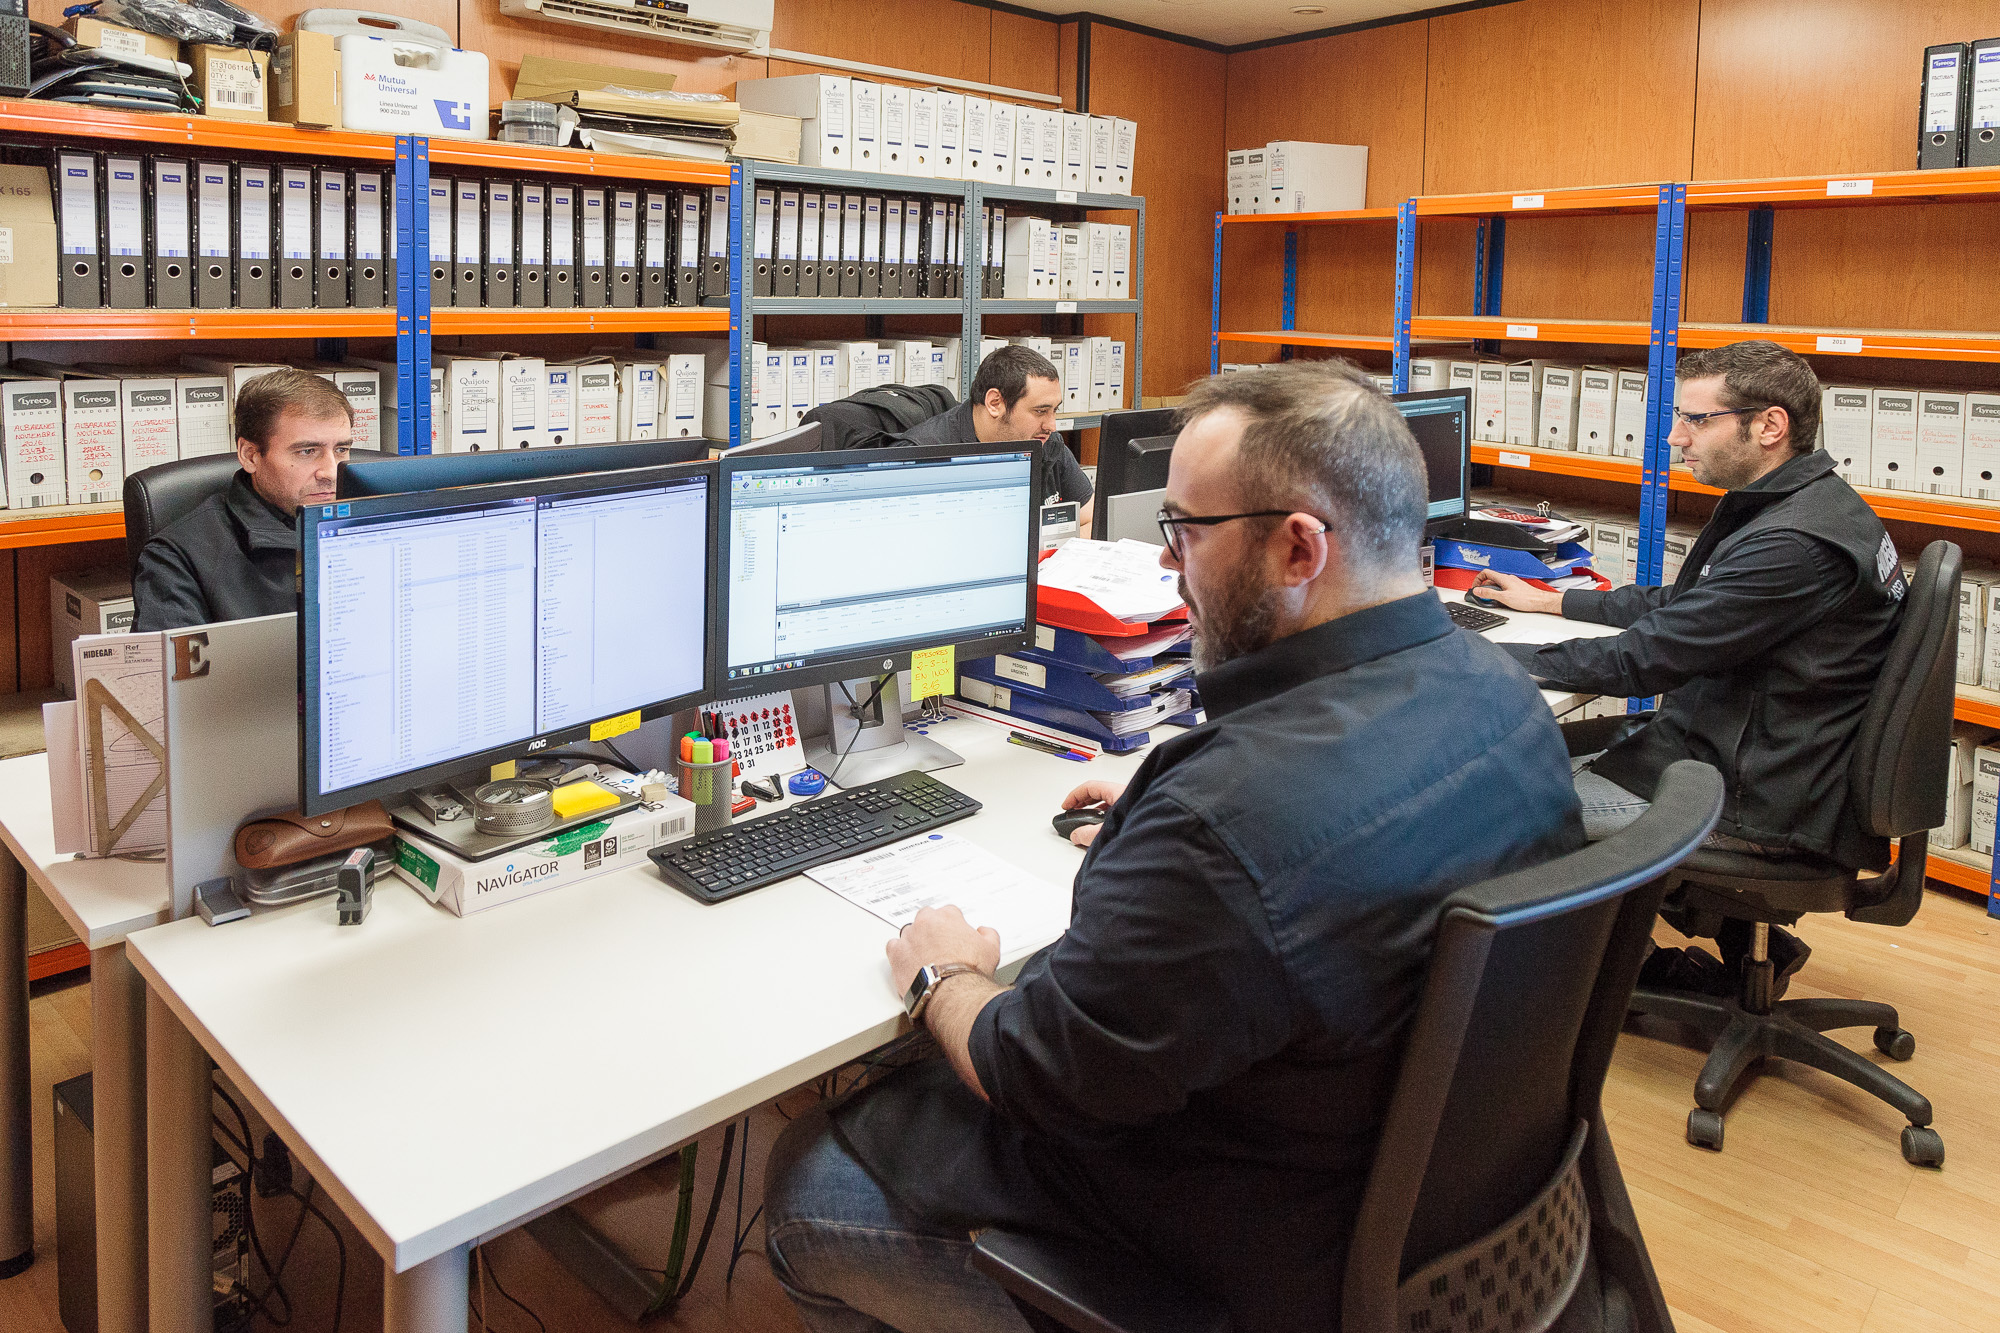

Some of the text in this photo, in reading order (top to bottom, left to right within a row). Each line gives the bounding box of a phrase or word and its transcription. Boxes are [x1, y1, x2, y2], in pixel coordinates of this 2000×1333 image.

[211, 62, 261, 73] C13T061140
[378, 75, 406, 85] Mutua
[378, 84, 417, 95] Universal
[394, 102, 418, 110] Universal
[9, 187, 31, 196] 165
[676, 369, 698, 377] Quijote
[459, 377, 490, 386] Quijote
[510, 375, 537, 384] Quijote
[347, 383, 373, 394] Lyreco
[79, 394, 111, 405] Lyreco
[136, 393, 167, 403] Lyreco
[190, 390, 219, 400] Lyreco
[19, 396, 51, 406] Lyreco
[1837, 396, 1863, 405] Lyreco
[1882, 399, 1908, 409] Lyreco
[1928, 403, 1955, 412] Lyreco
[83, 648, 113, 659] HIDEGAR
[170, 631, 210, 681] E
[1012, 662, 1028, 670] PEDIDOS
[932, 668, 950, 678] INOX
[741, 727, 748, 735] 10
[753, 724, 759, 732] 11
[762, 721, 770, 729] 12
[528, 739, 546, 751] AOC
[732, 741, 740, 749] 16
[743, 737, 750, 746] 17
[754, 735, 761, 743] 18
[764, 732, 772, 740] 19
[734, 740, 784, 760] 23 24 25 26 27
[747, 759, 755, 768] 31
[477, 861, 559, 894] NAVIGATOR
